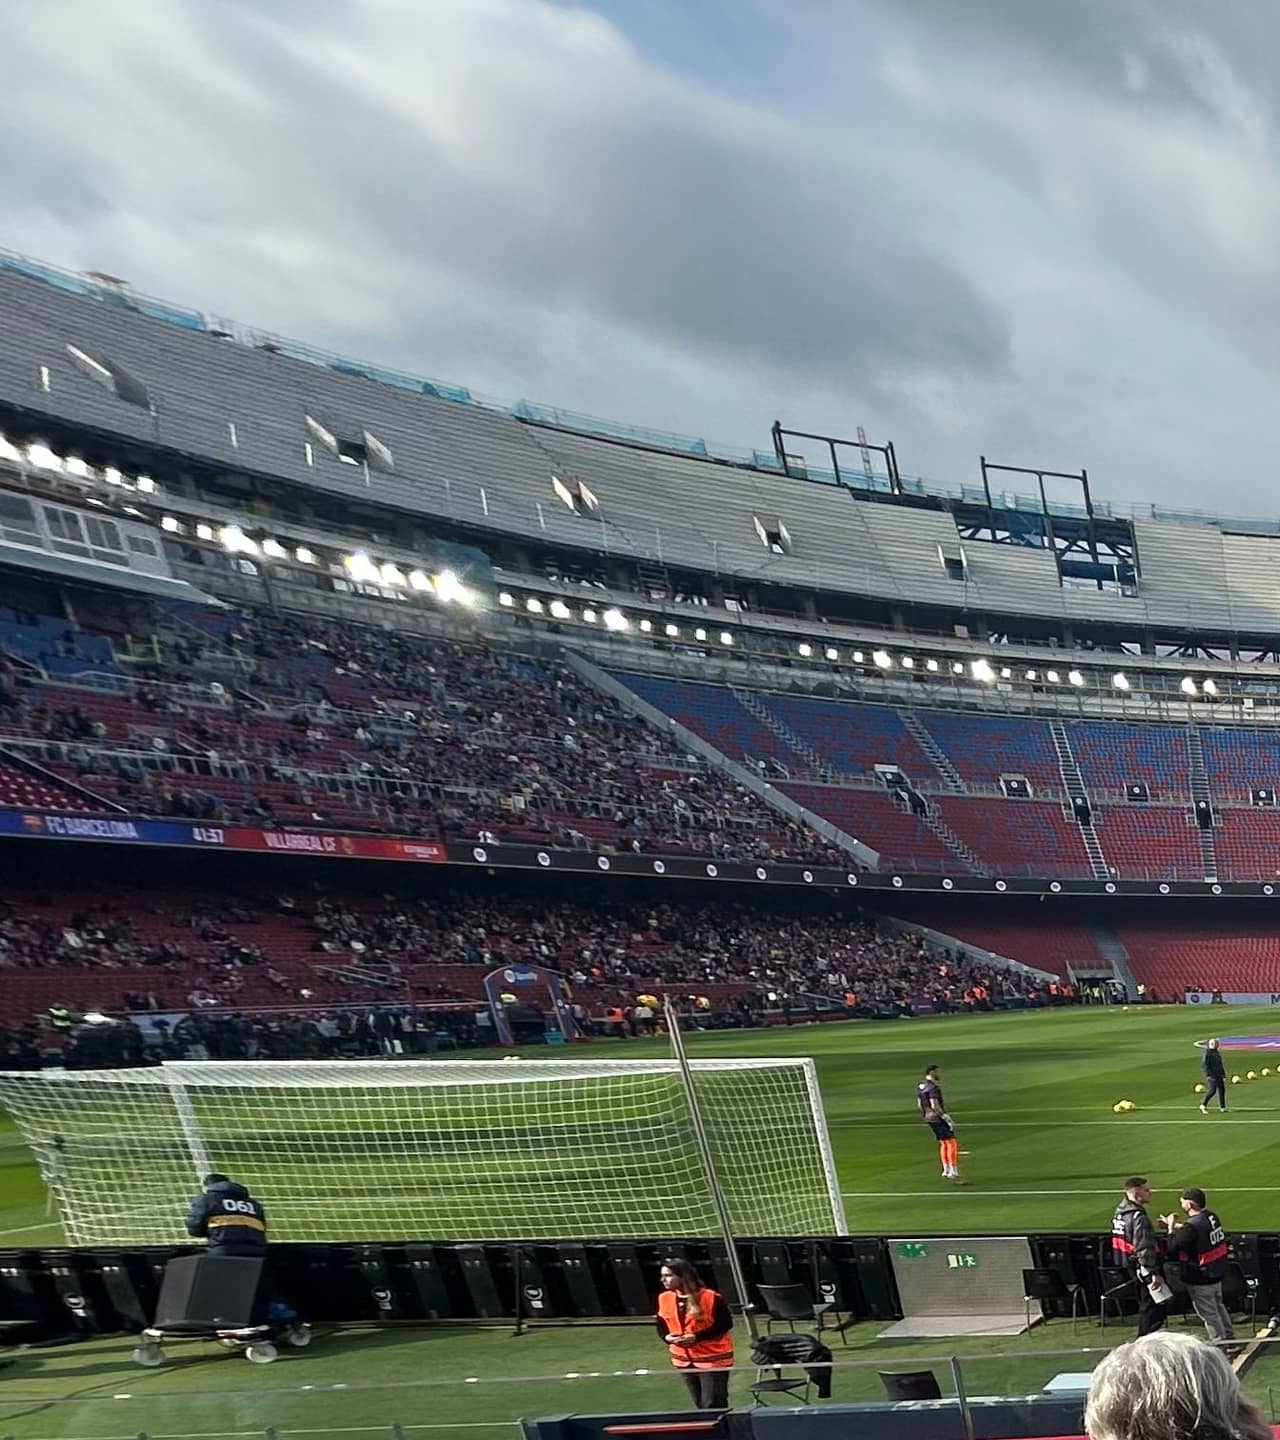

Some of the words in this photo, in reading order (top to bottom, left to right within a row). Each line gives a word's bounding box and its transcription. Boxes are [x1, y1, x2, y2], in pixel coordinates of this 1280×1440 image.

[44, 815, 66, 834] FC
[65, 817, 139, 838] BARCELONA
[263, 832, 324, 850] VILLARREAL
[222, 1199, 257, 1215] 061
